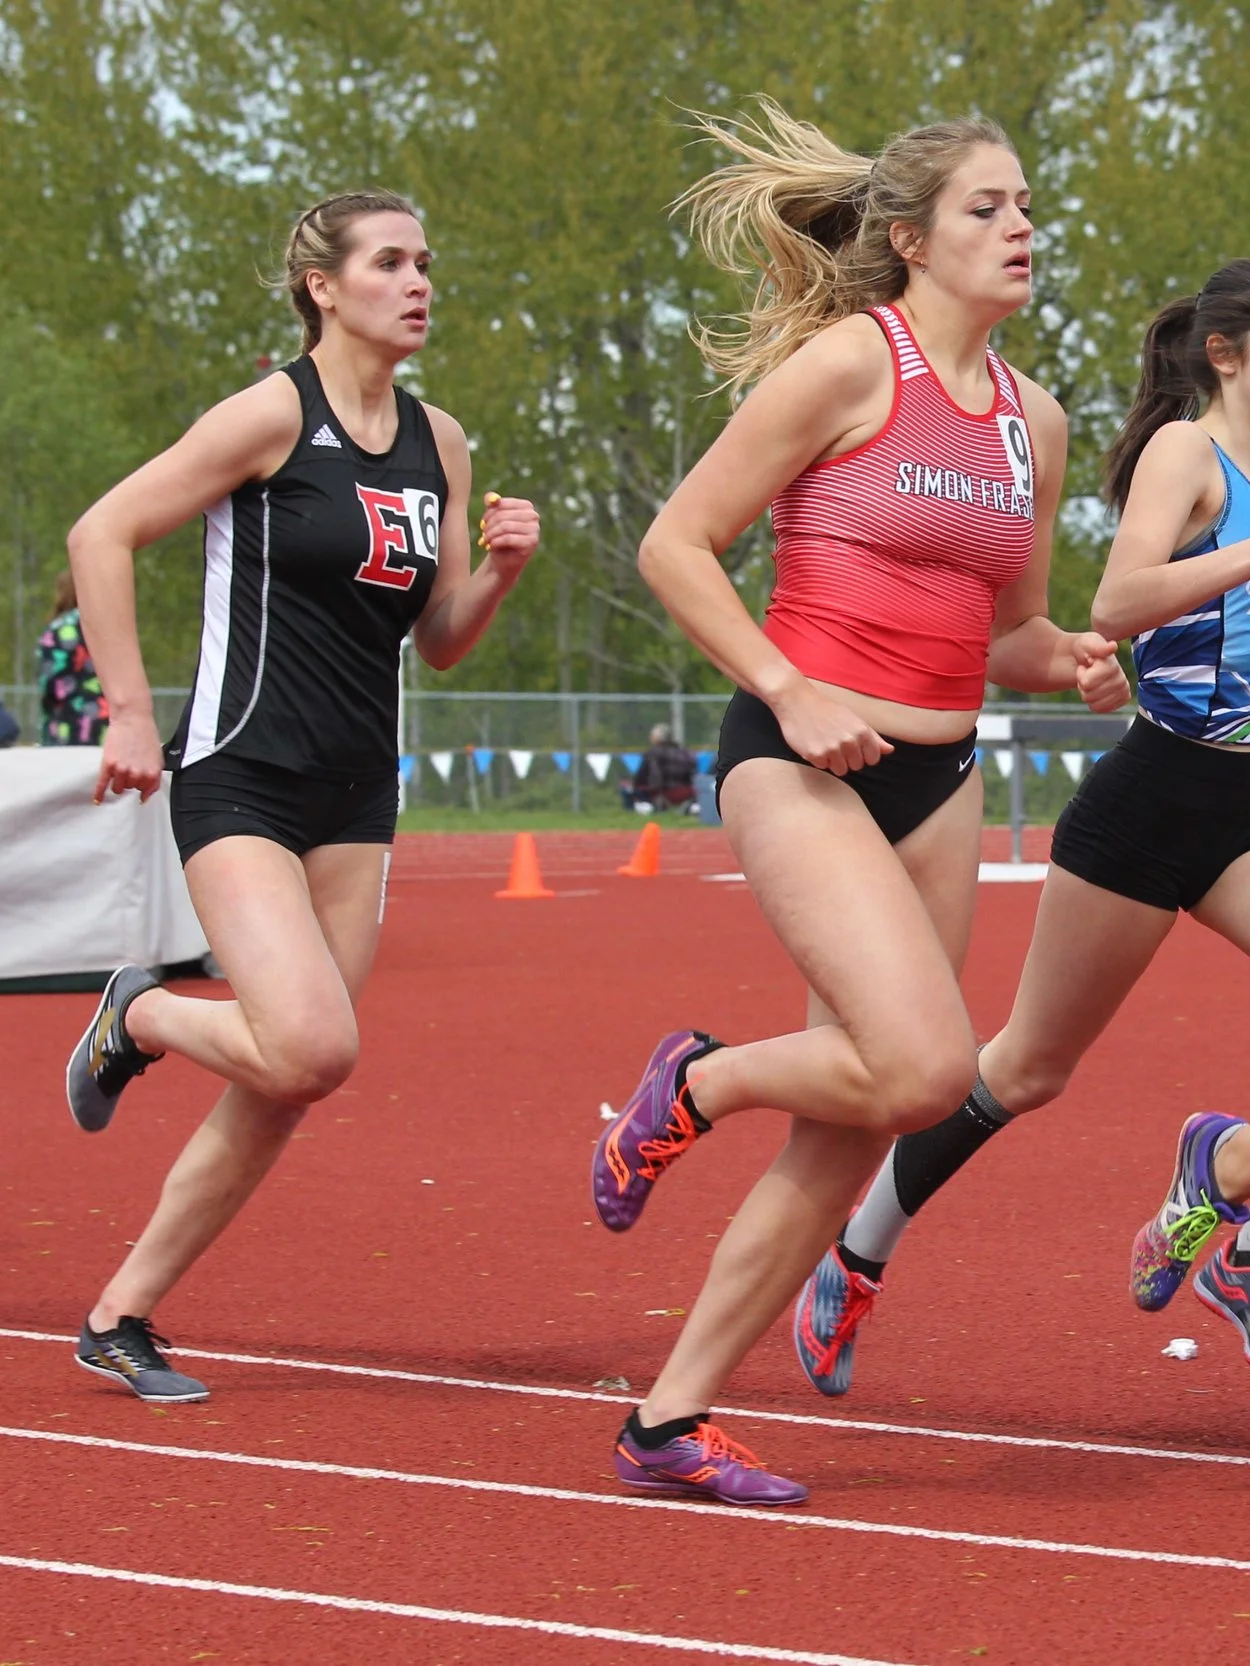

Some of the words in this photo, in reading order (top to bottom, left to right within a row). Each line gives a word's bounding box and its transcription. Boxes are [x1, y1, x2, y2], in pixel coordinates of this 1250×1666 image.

[311, 438, 342, 449] adidas
[1008, 420, 1030, 491] 9
[895, 461, 974, 504] SIMON
[354, 482, 417, 591] E
[418, 495, 437, 557] 6
